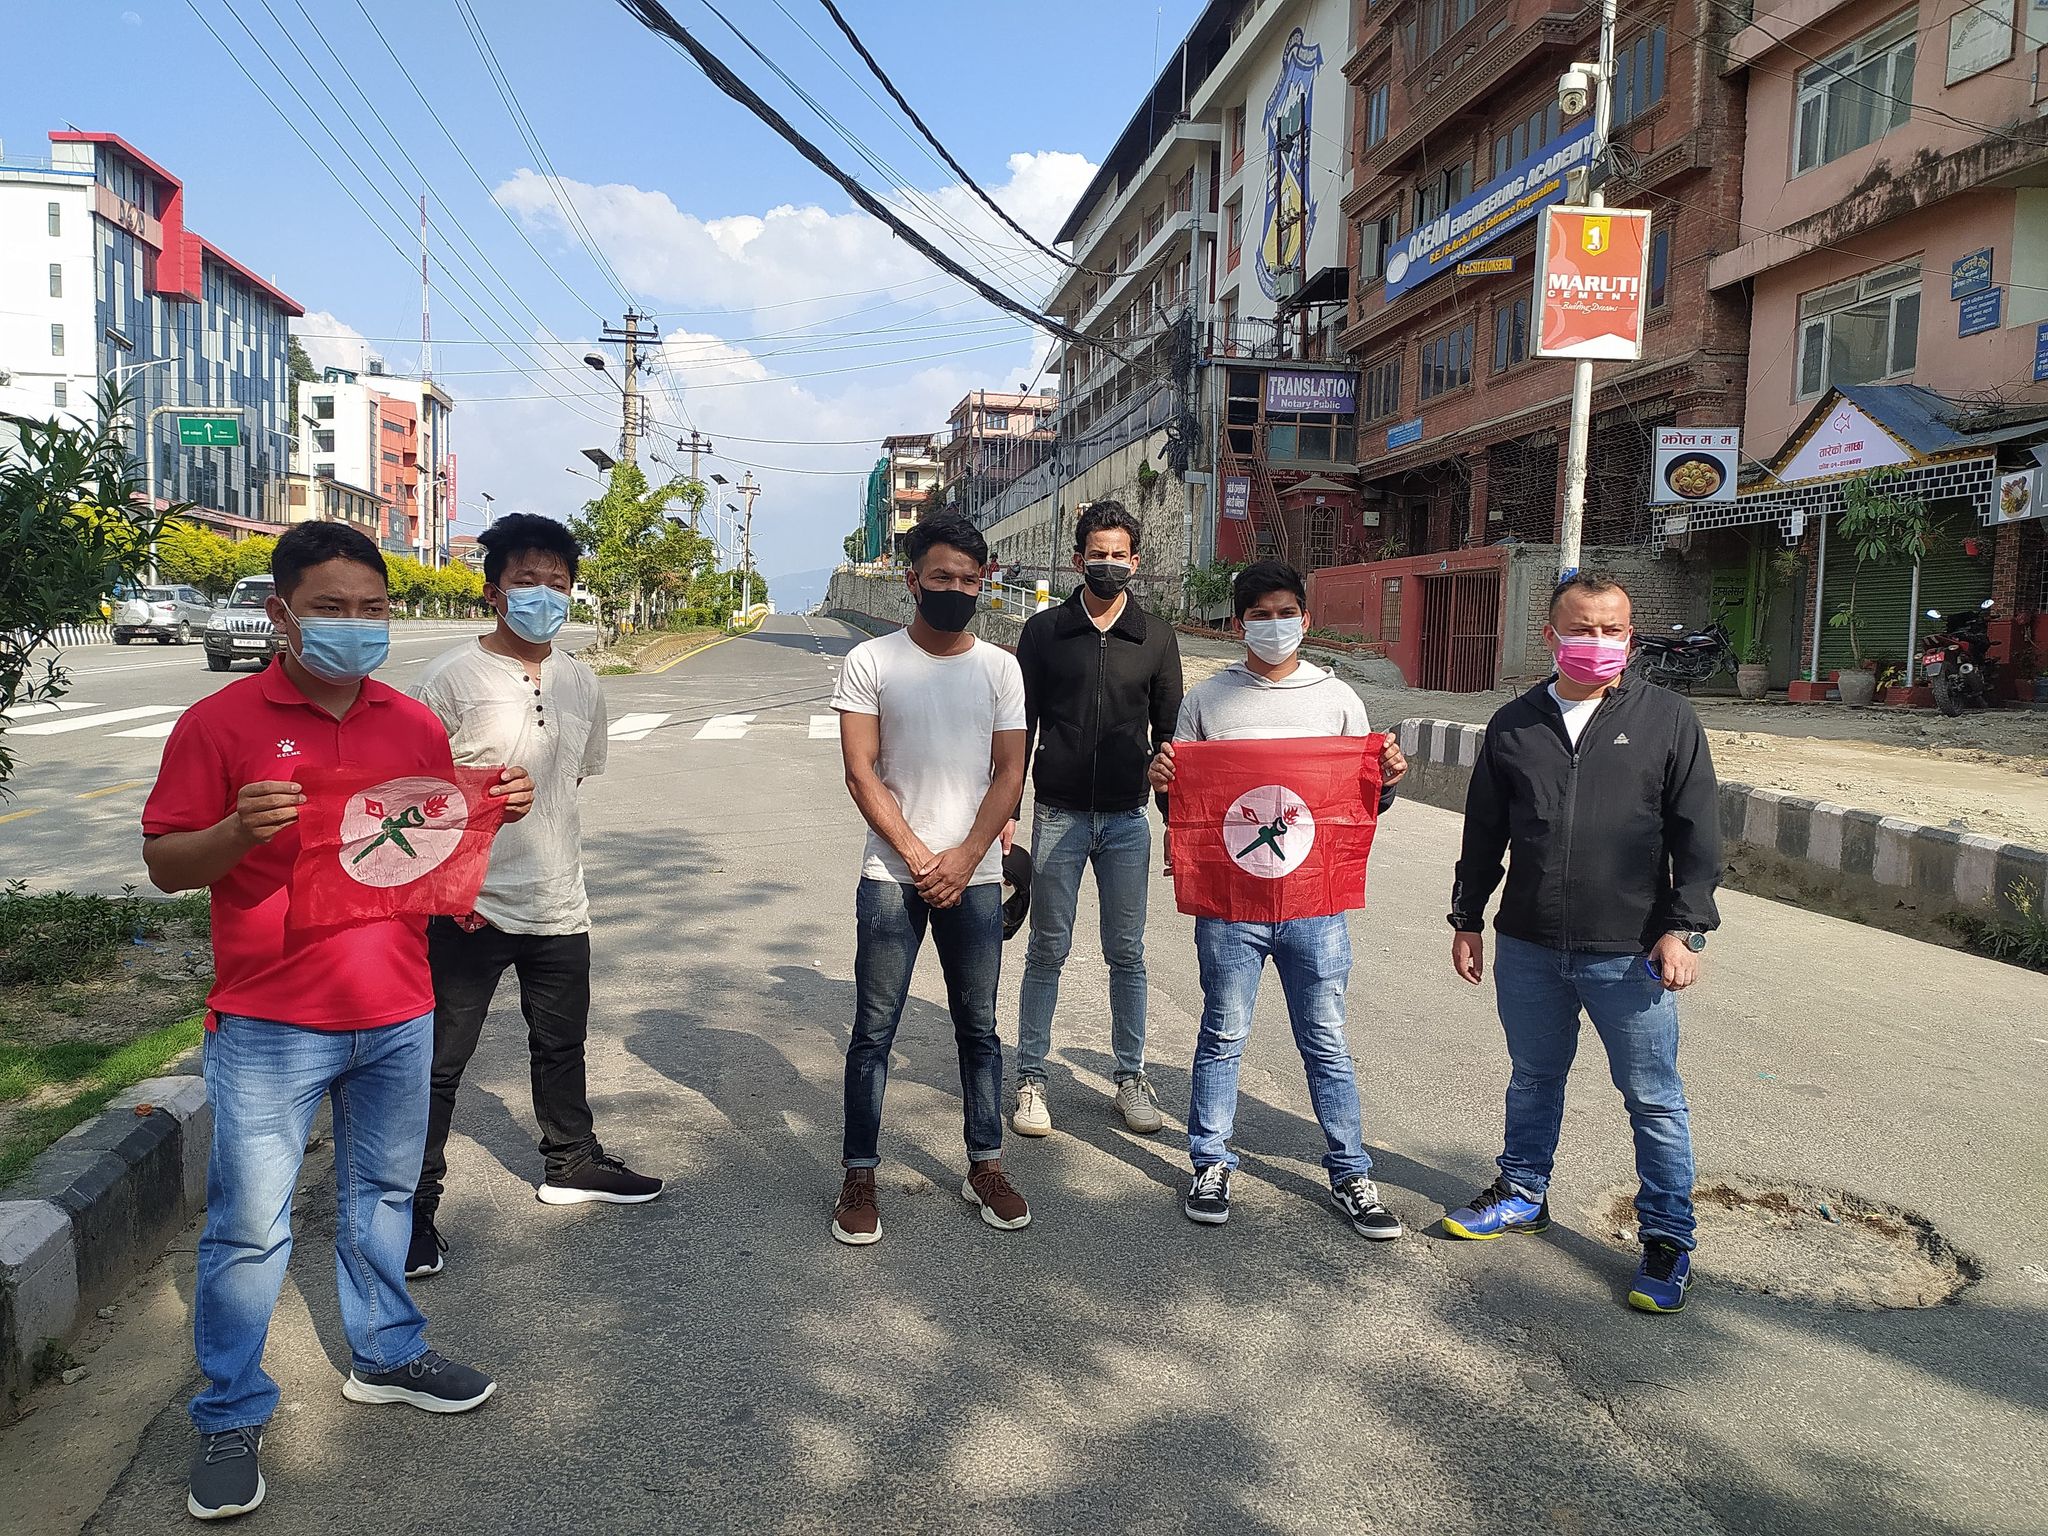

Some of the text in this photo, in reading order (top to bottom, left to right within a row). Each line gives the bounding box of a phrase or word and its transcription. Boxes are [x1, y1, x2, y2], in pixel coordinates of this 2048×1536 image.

[1408, 132, 1595, 263] OCEAN ENGINEERING ACADEMY
[1516, 178, 1561, 212] Preparation
[1588, 226, 1601, 250] 1
[1549, 273, 1638, 293] MARUTI
[1547, 289, 1638, 301] CEMENT
[1561, 300, 1618, 314] Building Dreams
[1269, 376, 1355, 398] TRANSLATION
[1281, 398, 1341, 410] Notary Public
[1661, 432, 1697, 446] झोल
[1819, 442, 1842, 458] तारेको
[276, 750, 302, 758] KELME
